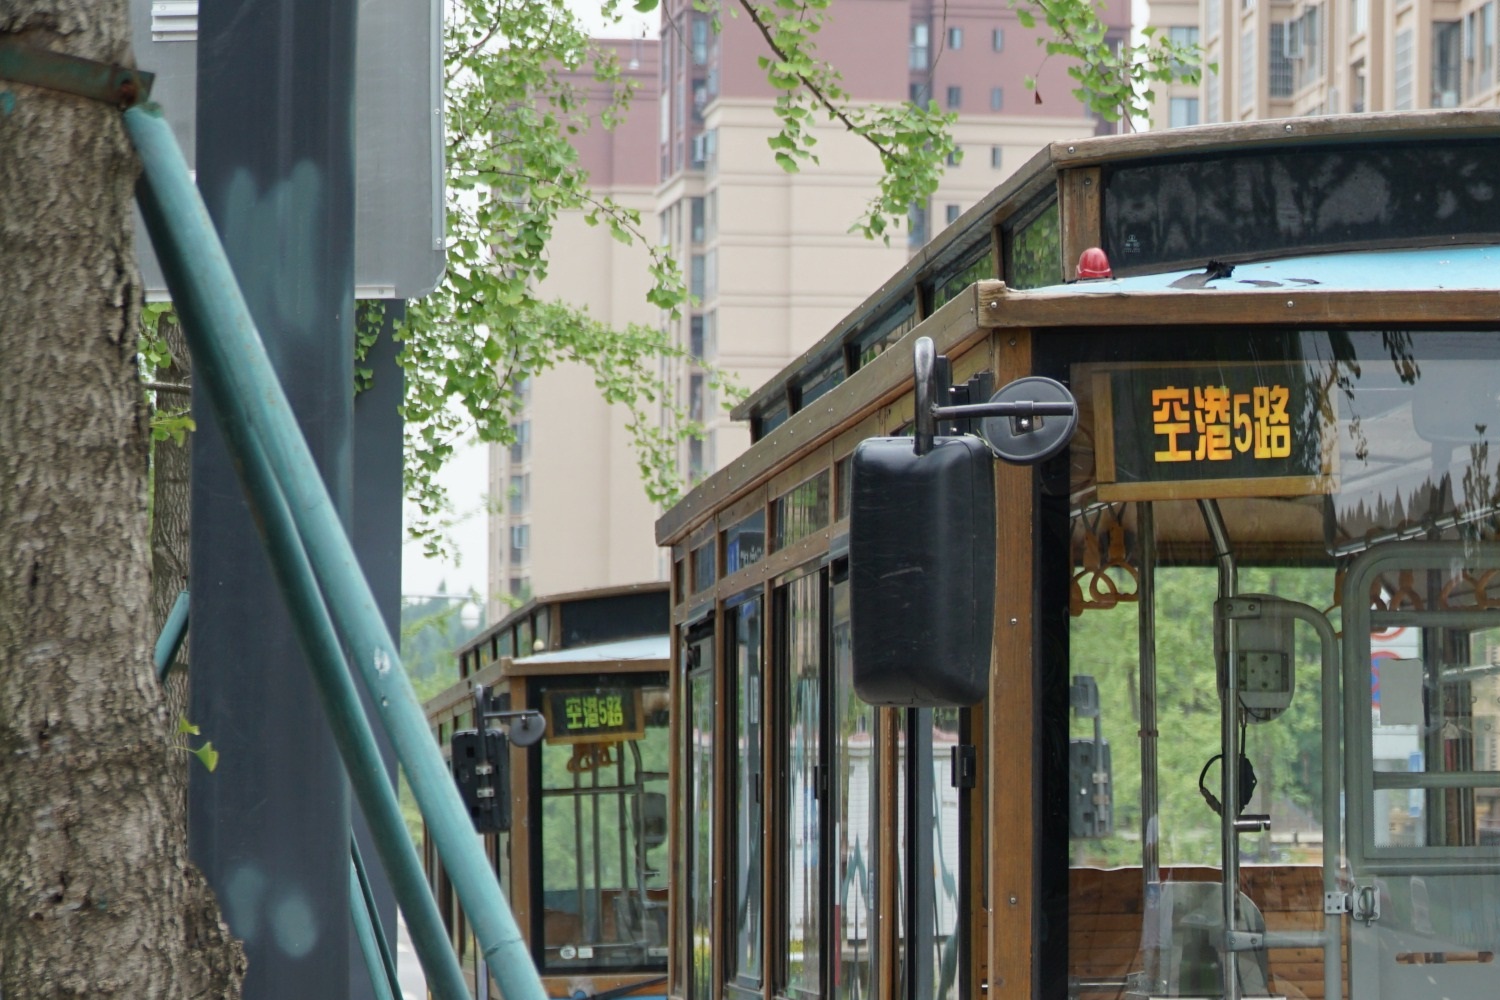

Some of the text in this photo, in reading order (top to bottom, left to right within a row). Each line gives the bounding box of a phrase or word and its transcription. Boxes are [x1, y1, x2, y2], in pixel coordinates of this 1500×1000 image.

[1152, 384, 1291, 463] 空港5路
[565, 695, 624, 730] 空港5路
